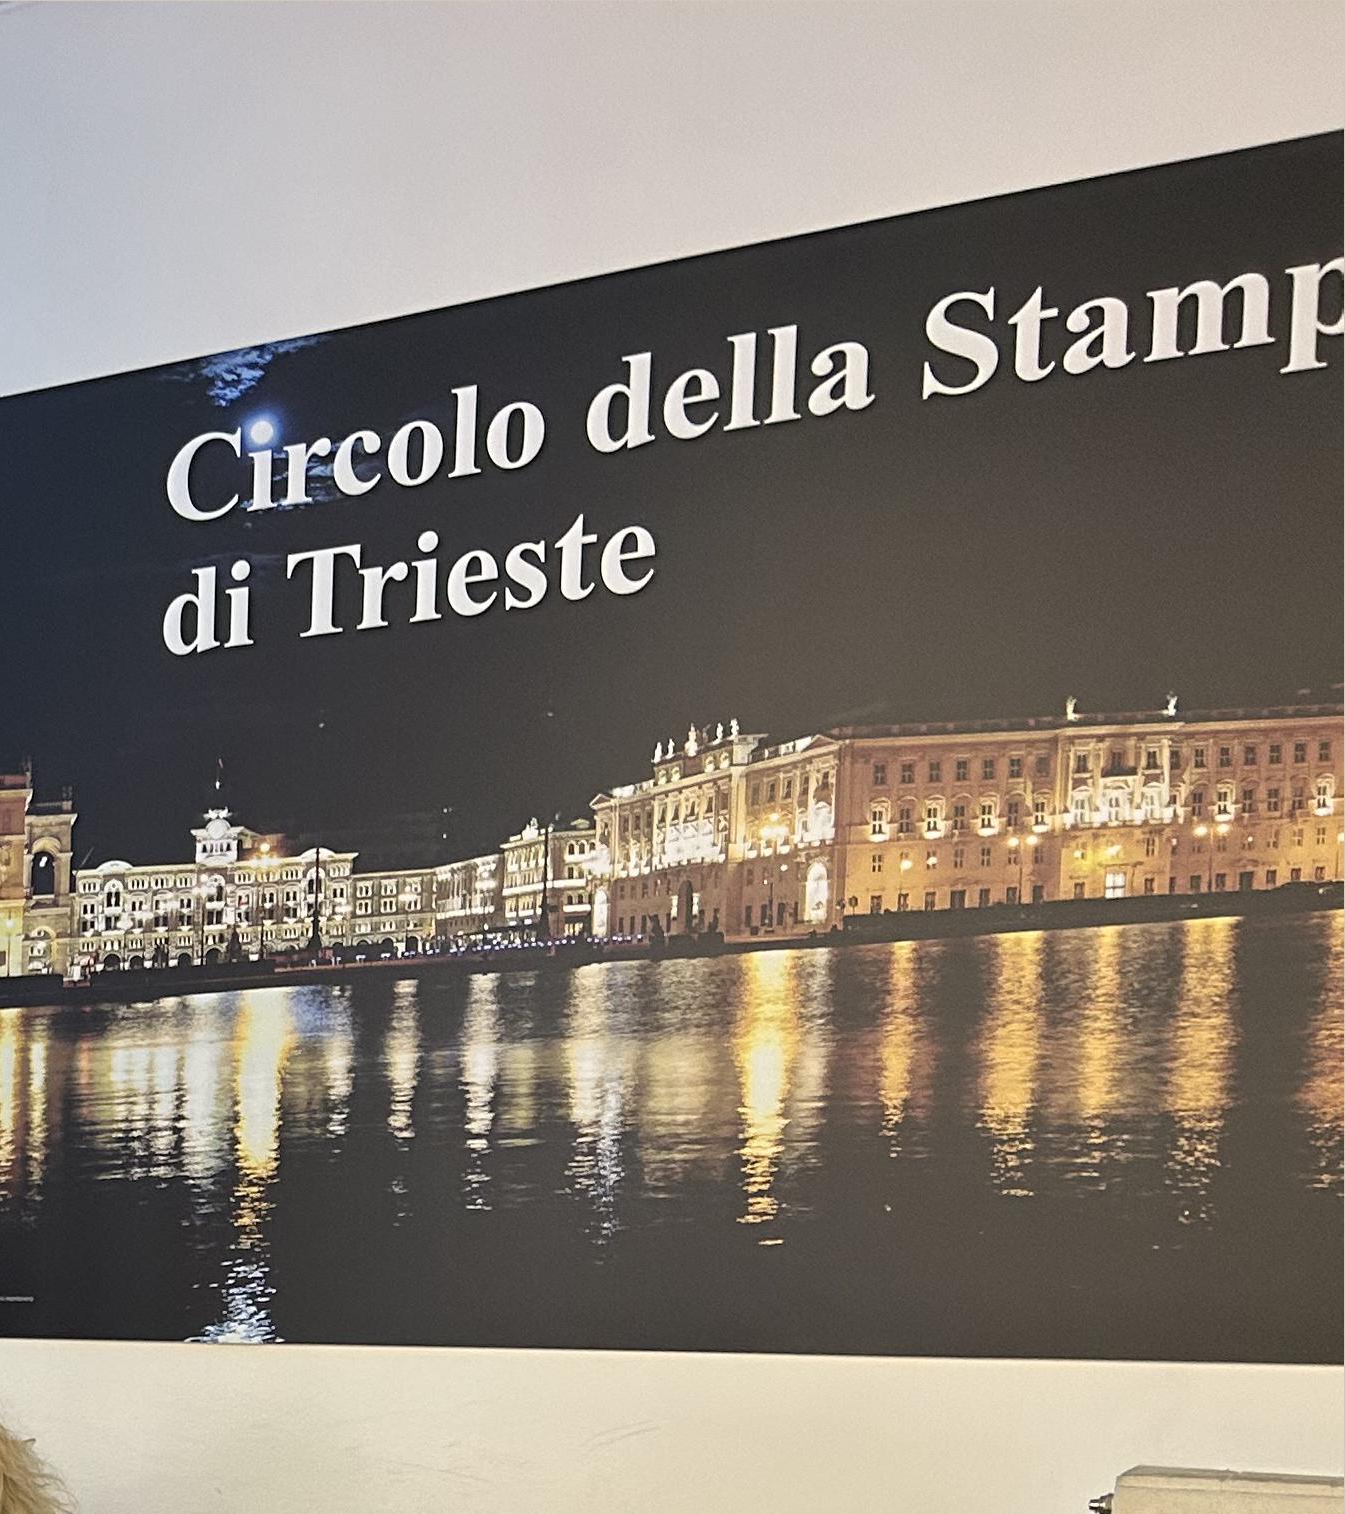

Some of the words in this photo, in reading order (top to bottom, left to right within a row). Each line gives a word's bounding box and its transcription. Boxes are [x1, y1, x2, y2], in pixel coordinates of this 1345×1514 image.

[166, 384, 546, 521] Circolo
[586, 324, 876, 454] della
[162, 559, 254, 656] di
[286, 513, 657, 638] Trieste
